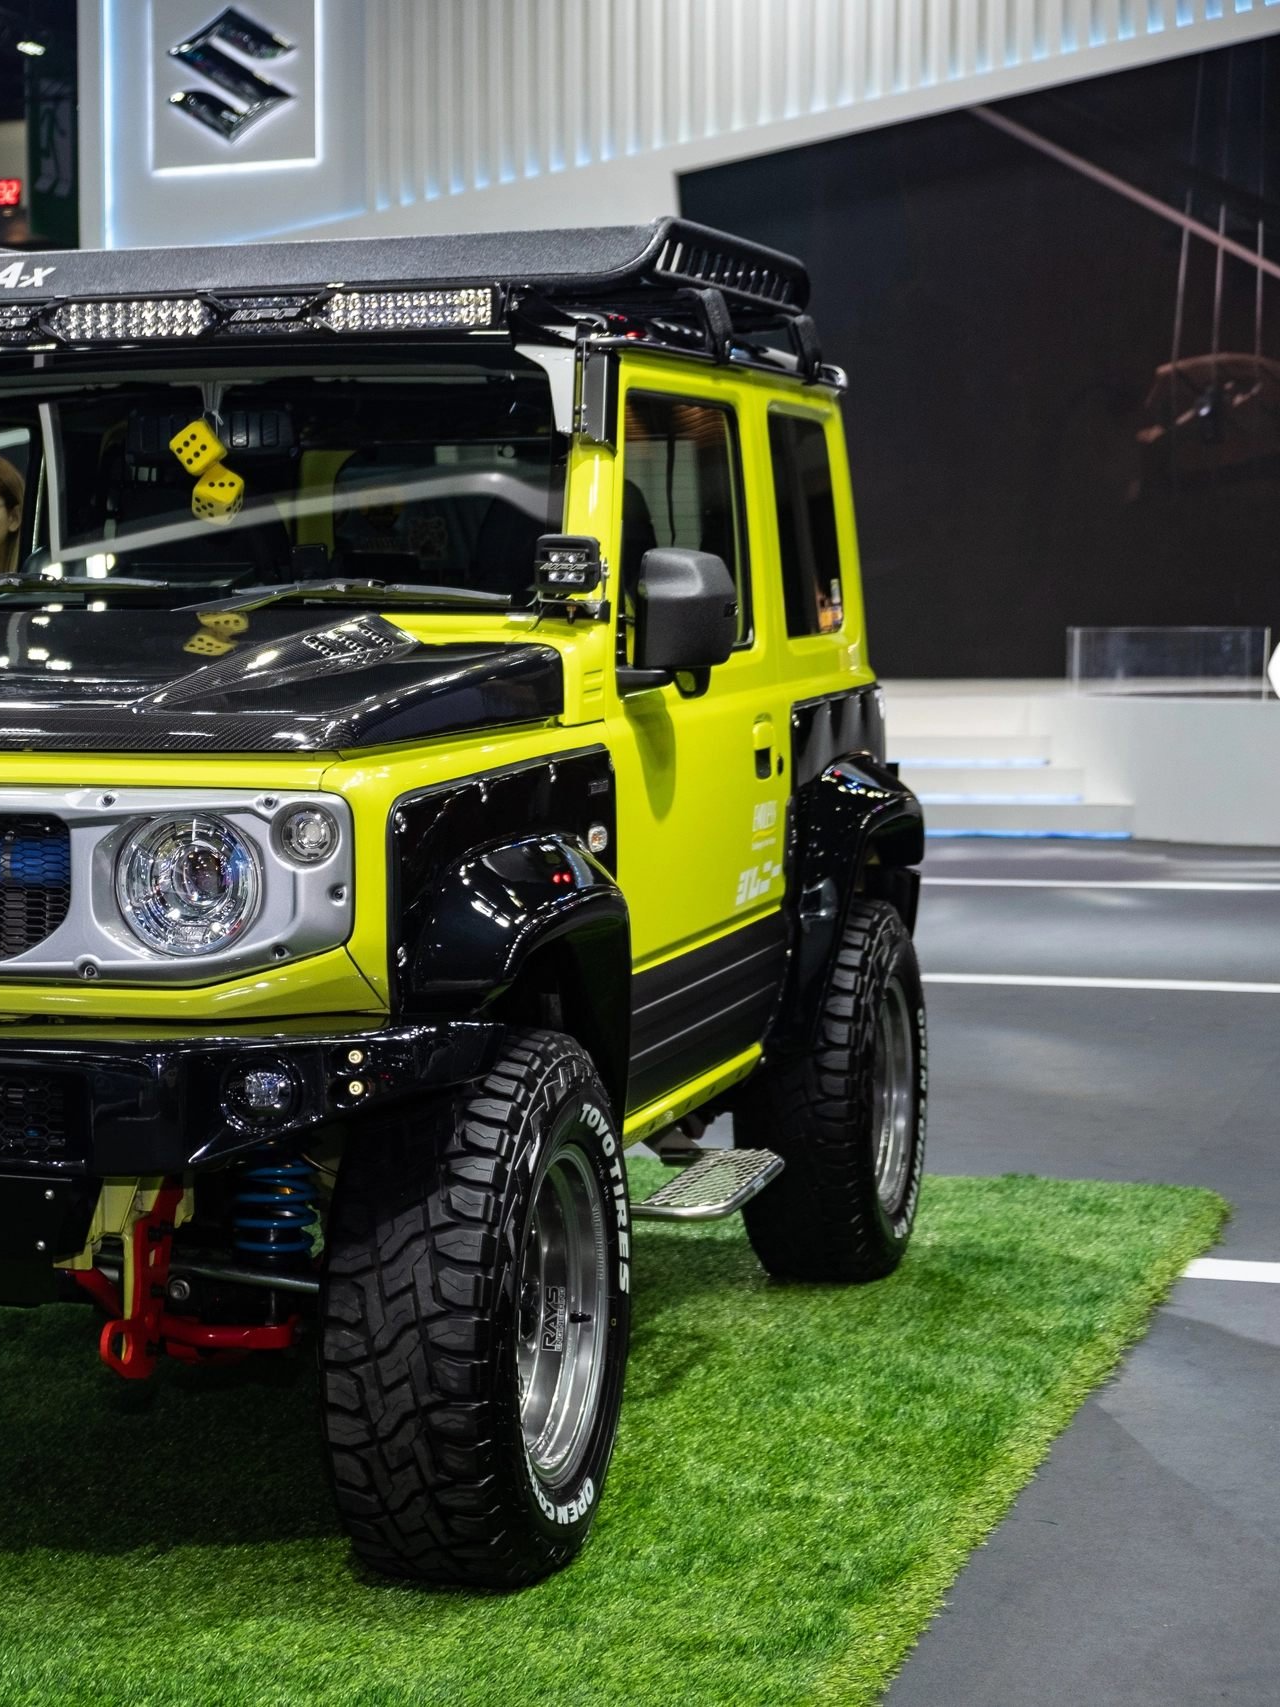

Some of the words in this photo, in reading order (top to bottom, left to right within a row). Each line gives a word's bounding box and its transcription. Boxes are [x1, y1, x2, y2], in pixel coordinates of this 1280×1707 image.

[579, 1103, 616, 1157] TOYO
[609, 1158, 630, 1294] TIRES
[542, 1286, 558, 1351] RAYS
[557, 1477, 594, 1525] OPEN
